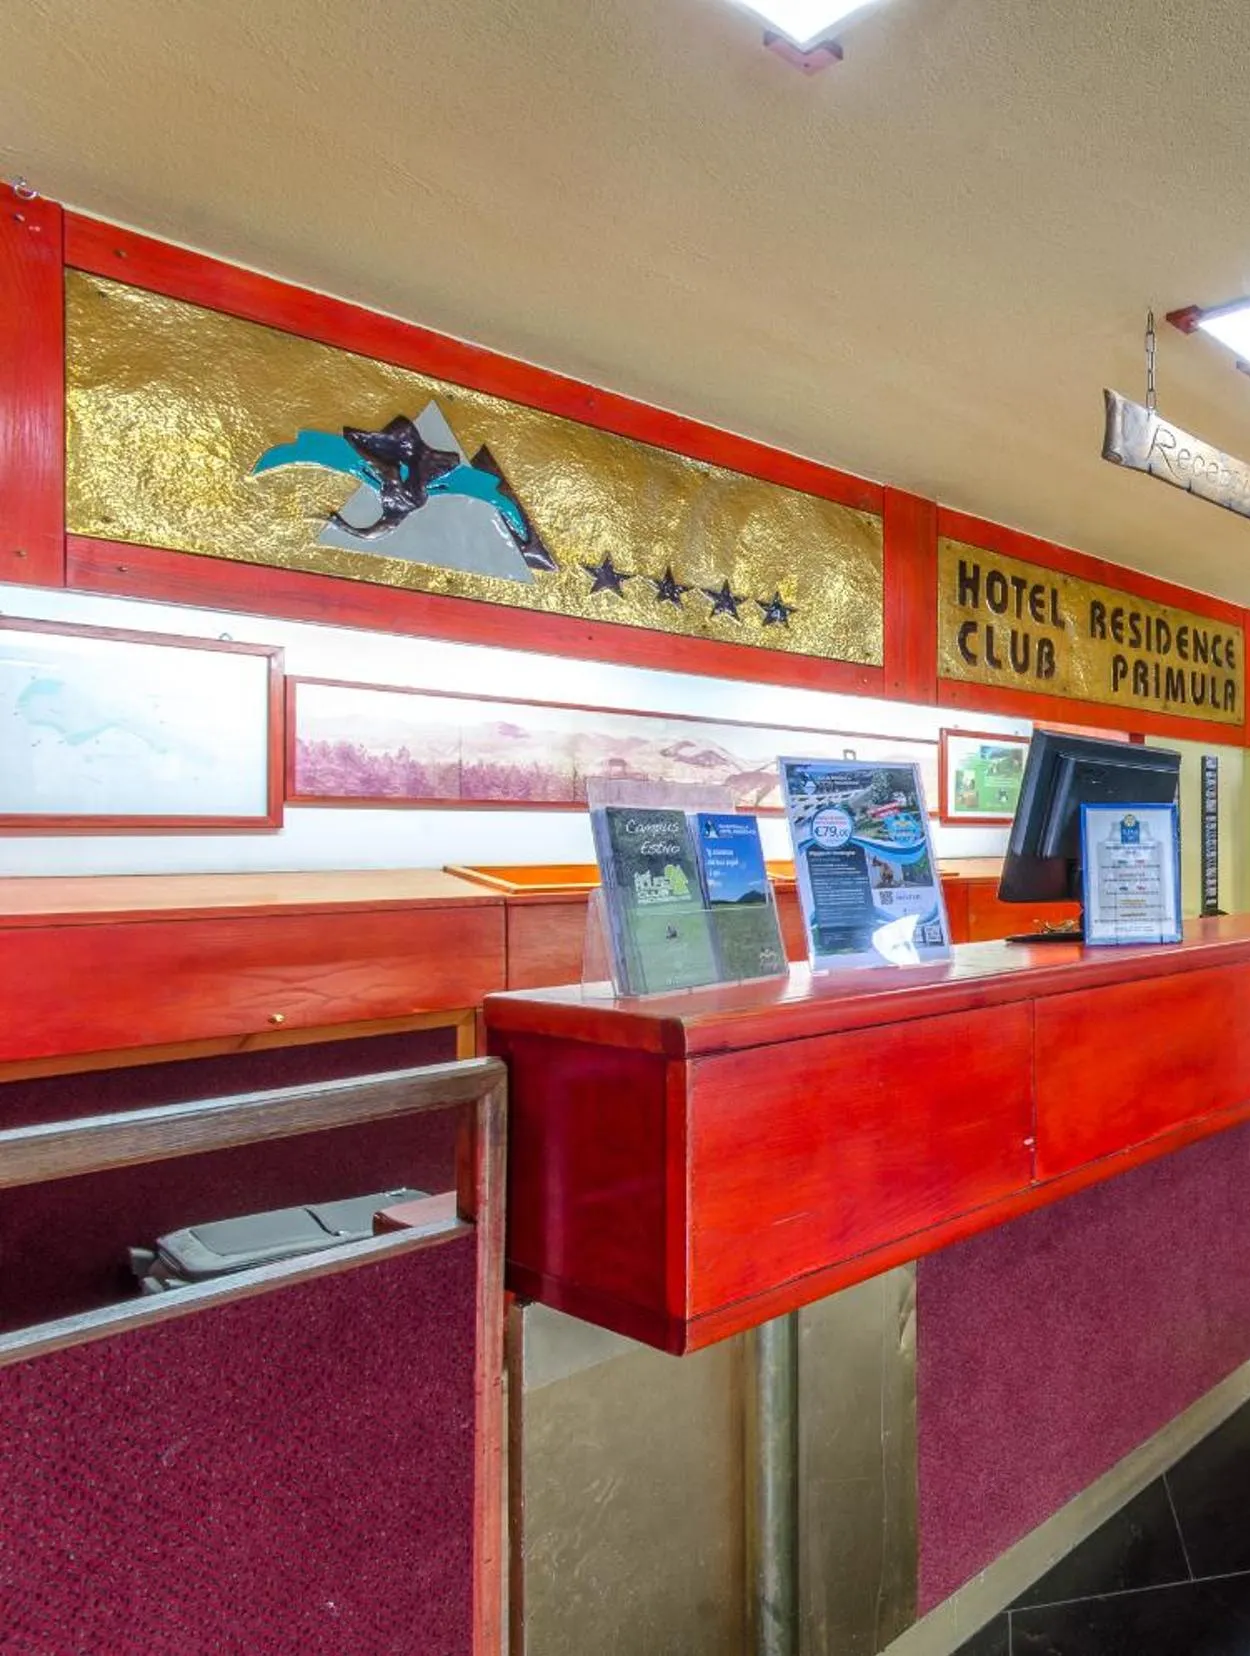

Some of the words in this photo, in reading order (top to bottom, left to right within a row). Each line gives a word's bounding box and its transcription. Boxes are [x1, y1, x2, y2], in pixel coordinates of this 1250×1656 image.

[958, 559, 1066, 631] HOTEL
[1088, 599, 1237, 671] RESIDENCE
[957, 620, 1058, 680] CLUB
[1111, 653, 1237, 714] PRIMULA
[625, 818, 680, 838] Campus
